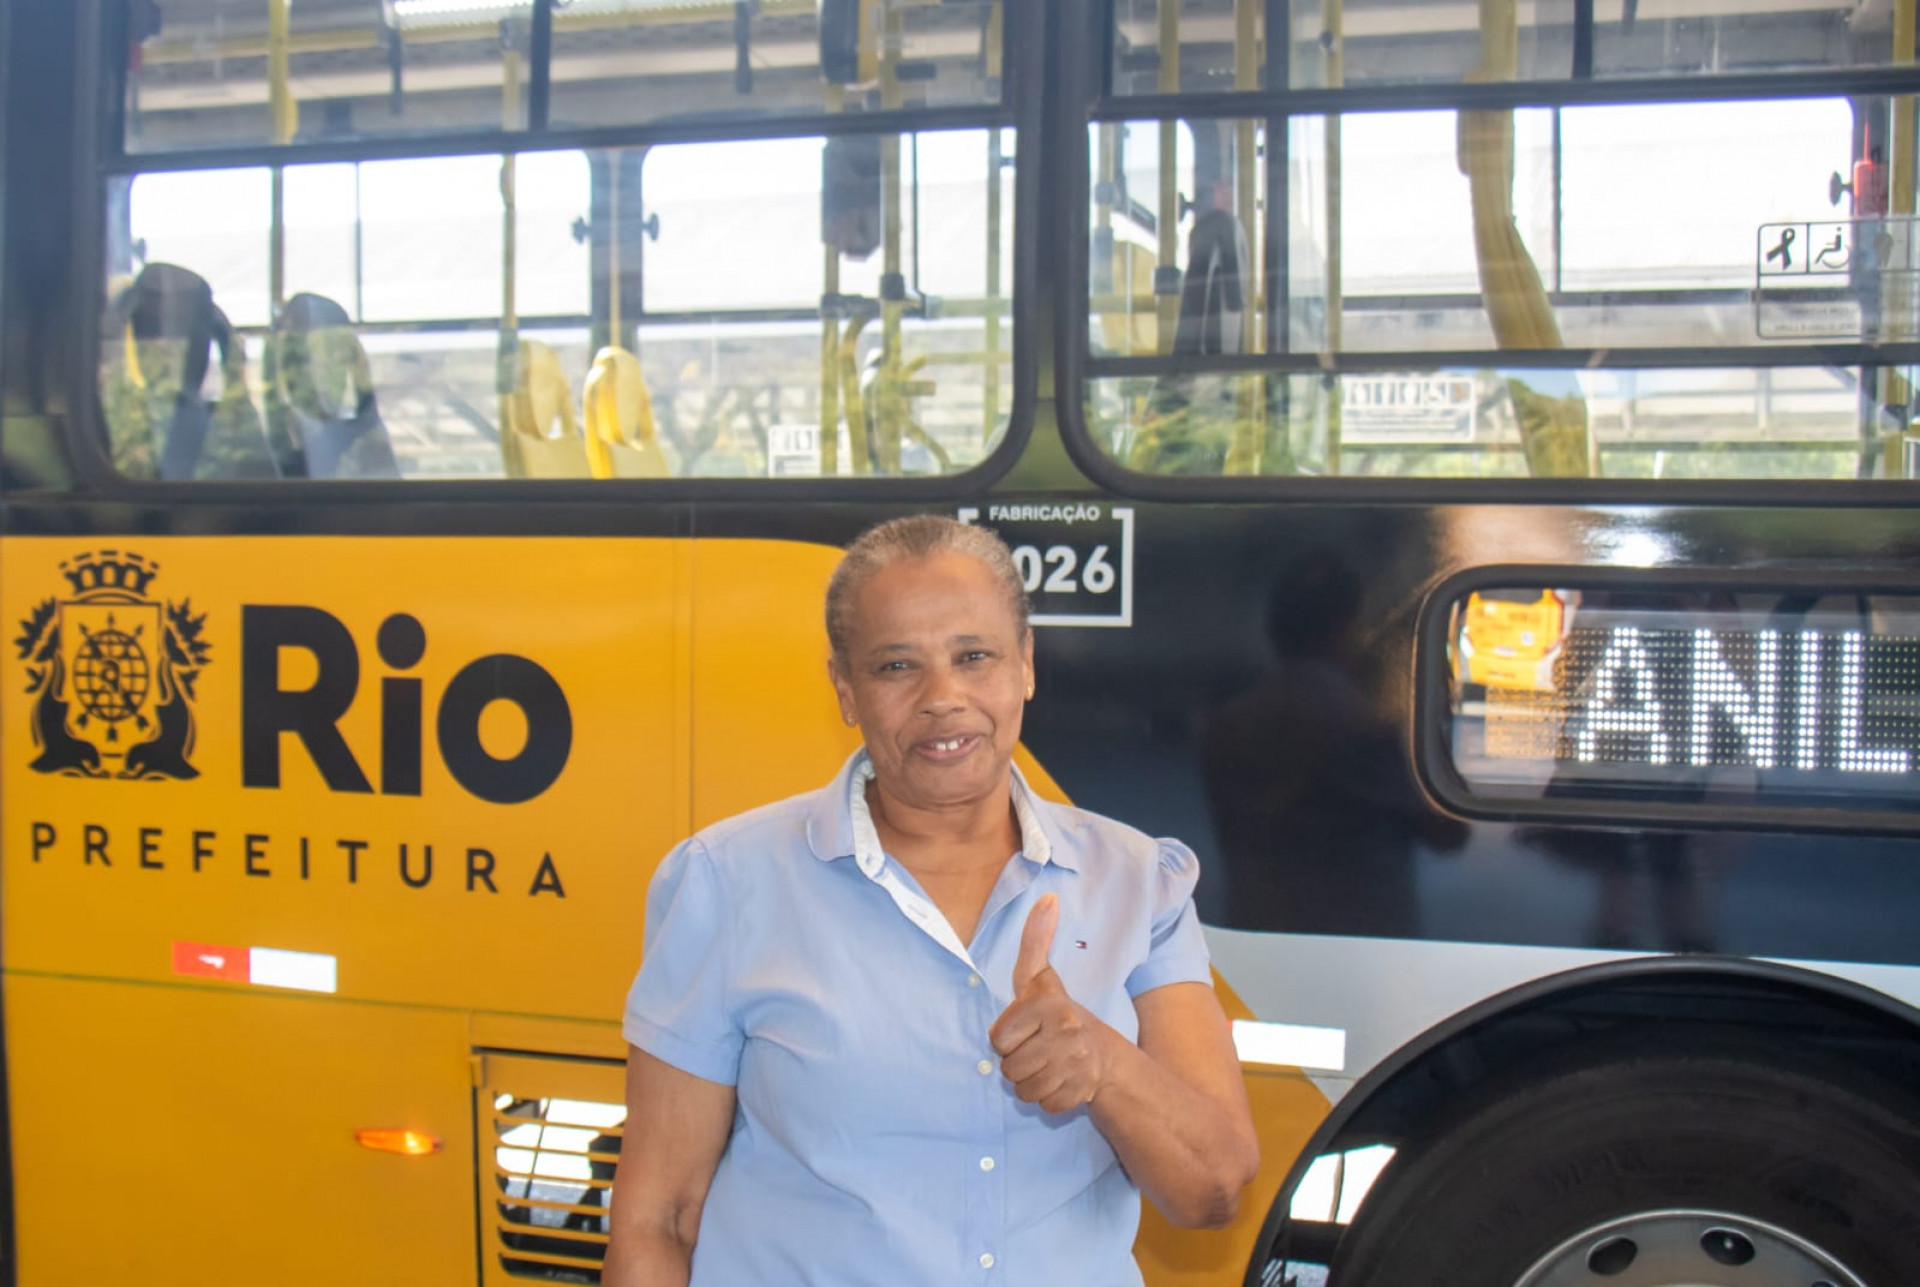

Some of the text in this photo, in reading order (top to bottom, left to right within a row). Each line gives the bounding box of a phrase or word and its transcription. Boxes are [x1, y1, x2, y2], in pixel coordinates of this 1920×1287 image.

[989, 503, 1101, 525] FABRICAÇÃO
[1012, 545, 1115, 594] 026
[241, 604, 573, 805] Rio
[1578, 628, 1908, 773] ANIL
[32, 821, 566, 898] PREFEITURA
